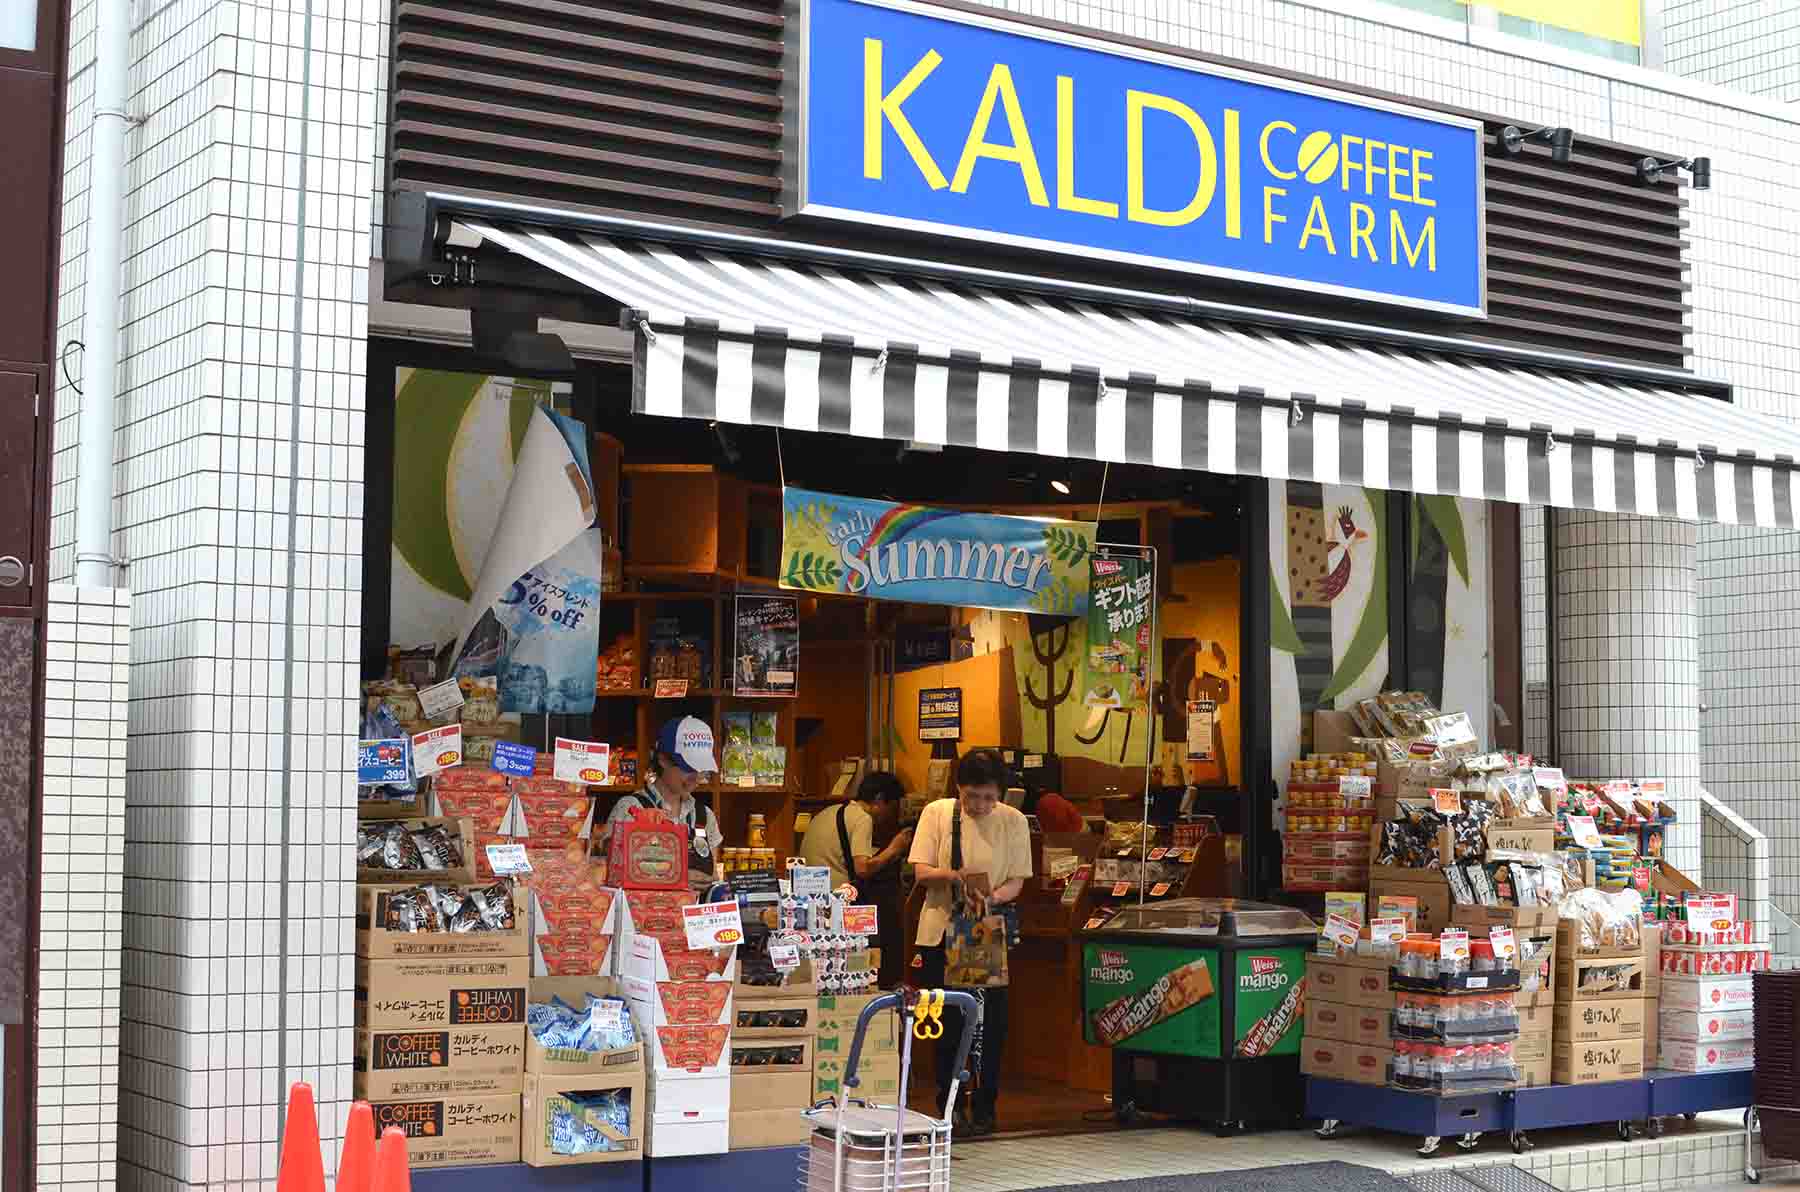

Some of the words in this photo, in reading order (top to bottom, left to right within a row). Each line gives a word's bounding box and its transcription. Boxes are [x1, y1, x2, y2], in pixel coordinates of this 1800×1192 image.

[863, 37, 1241, 239] KALDI
[1259, 119, 1437, 207] COFFEE
[1263, 186, 1438, 273] FARM
[840, 534, 1054, 594] Summer
[551, 608, 585, 630] off
[570, 743, 589, 752] SALE
[700, 905, 719, 915] SALE
[1091, 966, 1135, 984] mango
[1253, 960, 1275, 974] Weis
[1240, 973, 1288, 989] mango
[375, 1000, 445, 1012] コーヒーホワイト
[471, 991, 513, 1005] WHITE
[1121, 975, 1171, 1032] mango
[409, 1010, 445, 1022] カルディ
[457, 1005, 513, 1023] COFFEE
[1263, 983, 1301, 1046] mango
[386, 1034, 441, 1052] COFFEE
[453, 1034, 488, 1045] カルディ
[453, 1044, 521, 1056] コーヒーホワイト
[386, 1051, 429, 1067] WHITE
[379, 1103, 436, 1122] COFFEE
[448, 1104, 483, 1115] カルディ
[448, 1113, 517, 1126] コーヒーホワイト
